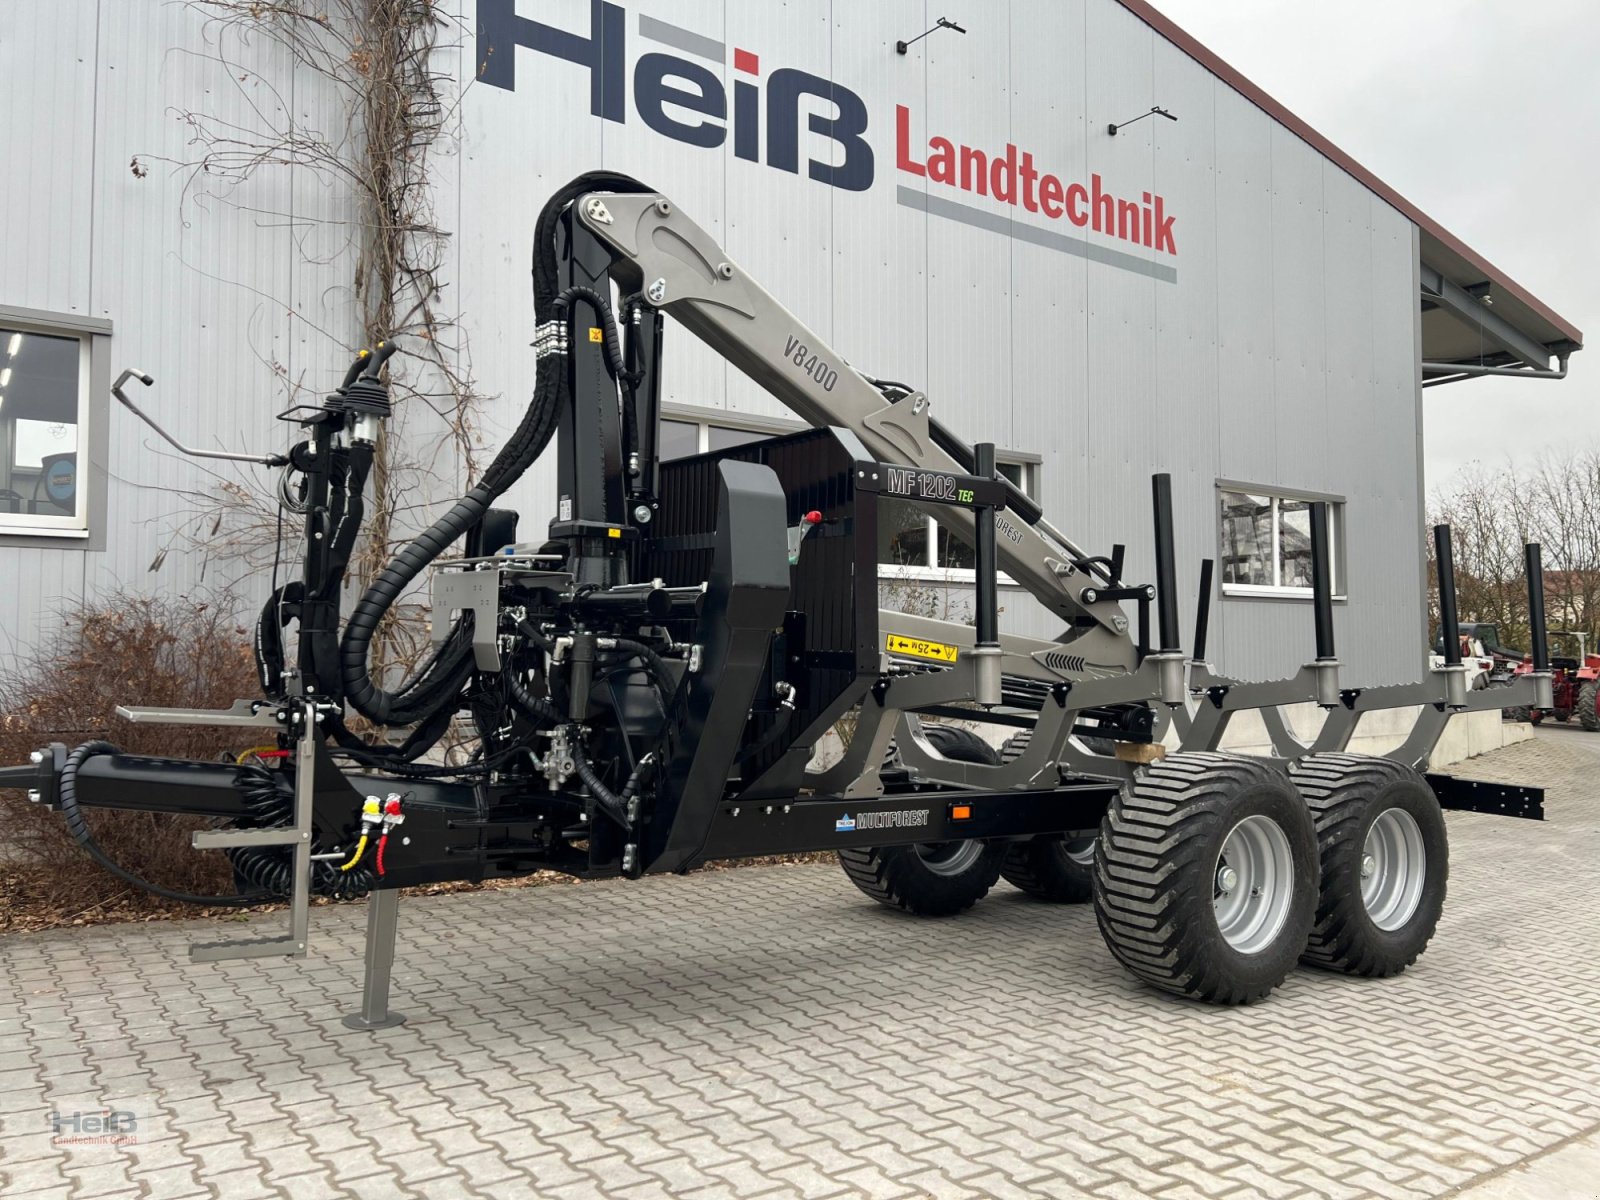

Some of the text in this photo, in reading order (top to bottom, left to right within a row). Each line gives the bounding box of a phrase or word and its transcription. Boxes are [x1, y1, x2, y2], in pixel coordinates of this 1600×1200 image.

[476, 0, 1178, 256] Heiß Landtechnik
[784, 334, 838, 392] V8400
[887, 468, 975, 503] MF 1202 TEC
[856, 810, 929, 829] MULTIFOREST
